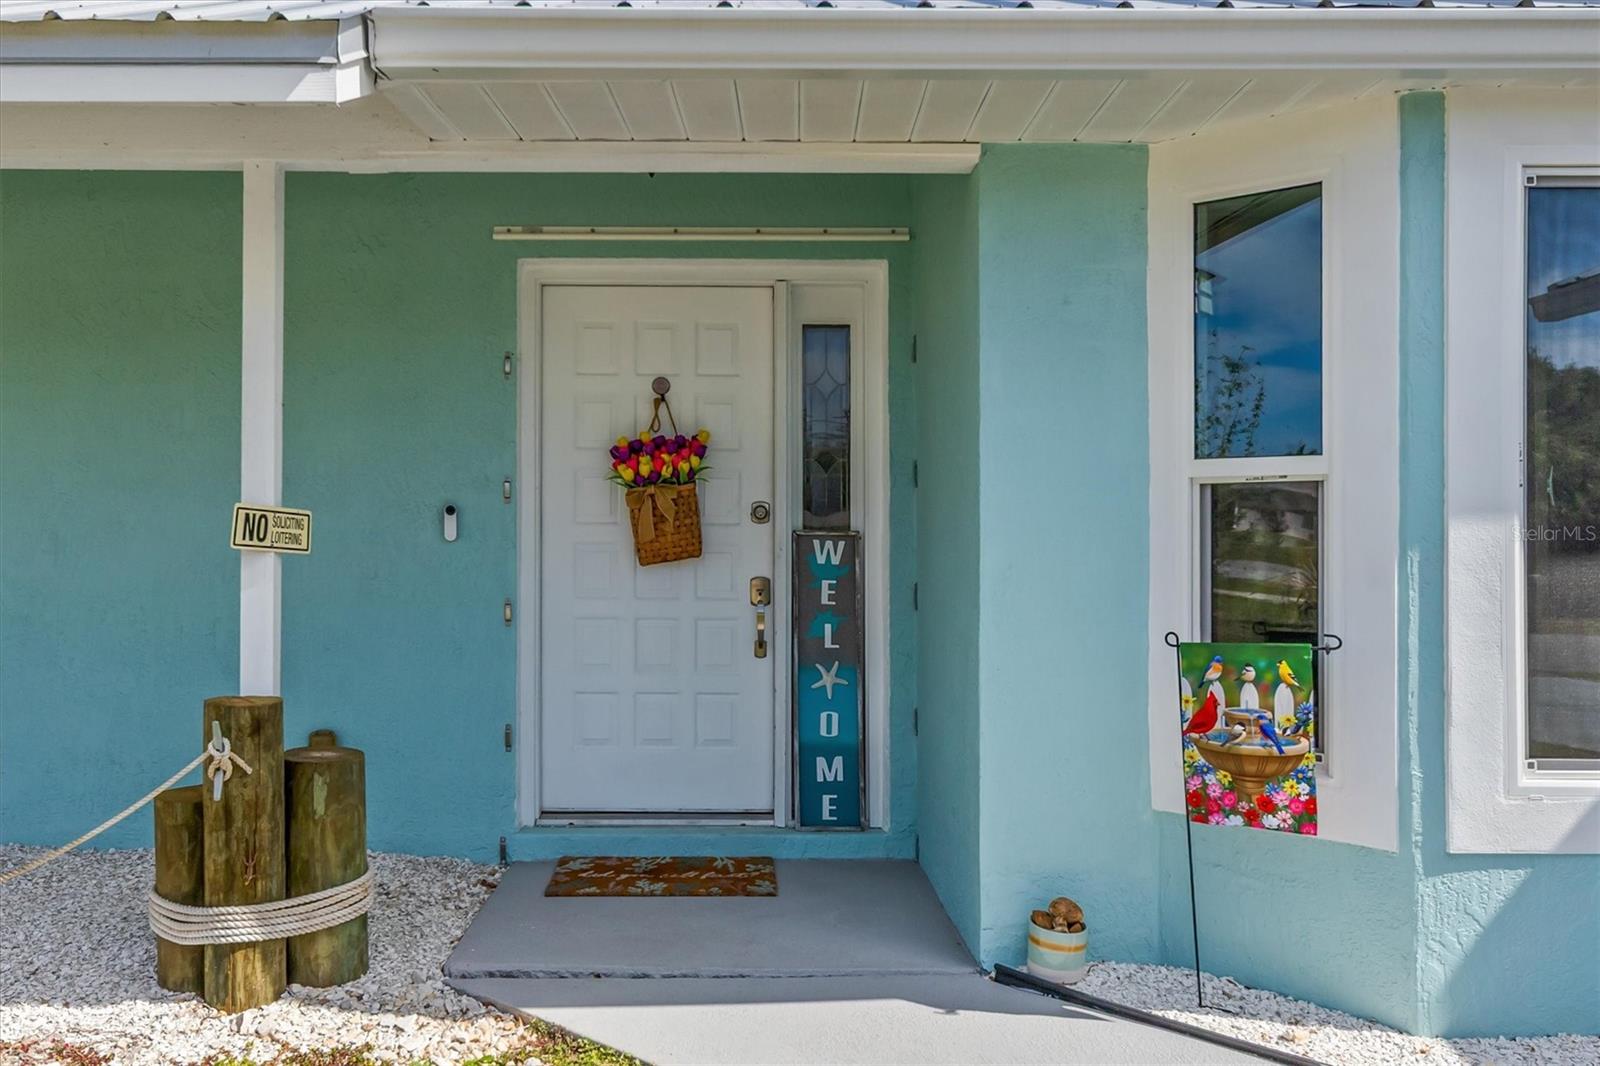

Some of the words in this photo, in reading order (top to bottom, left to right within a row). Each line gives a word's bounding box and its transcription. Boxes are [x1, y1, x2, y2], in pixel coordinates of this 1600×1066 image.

[242, 512, 268, 543] NO
[271, 514, 305, 531] SOLICITING
[270, 530, 303, 546] LOITERING
[810, 539, 849, 820] WELOME
